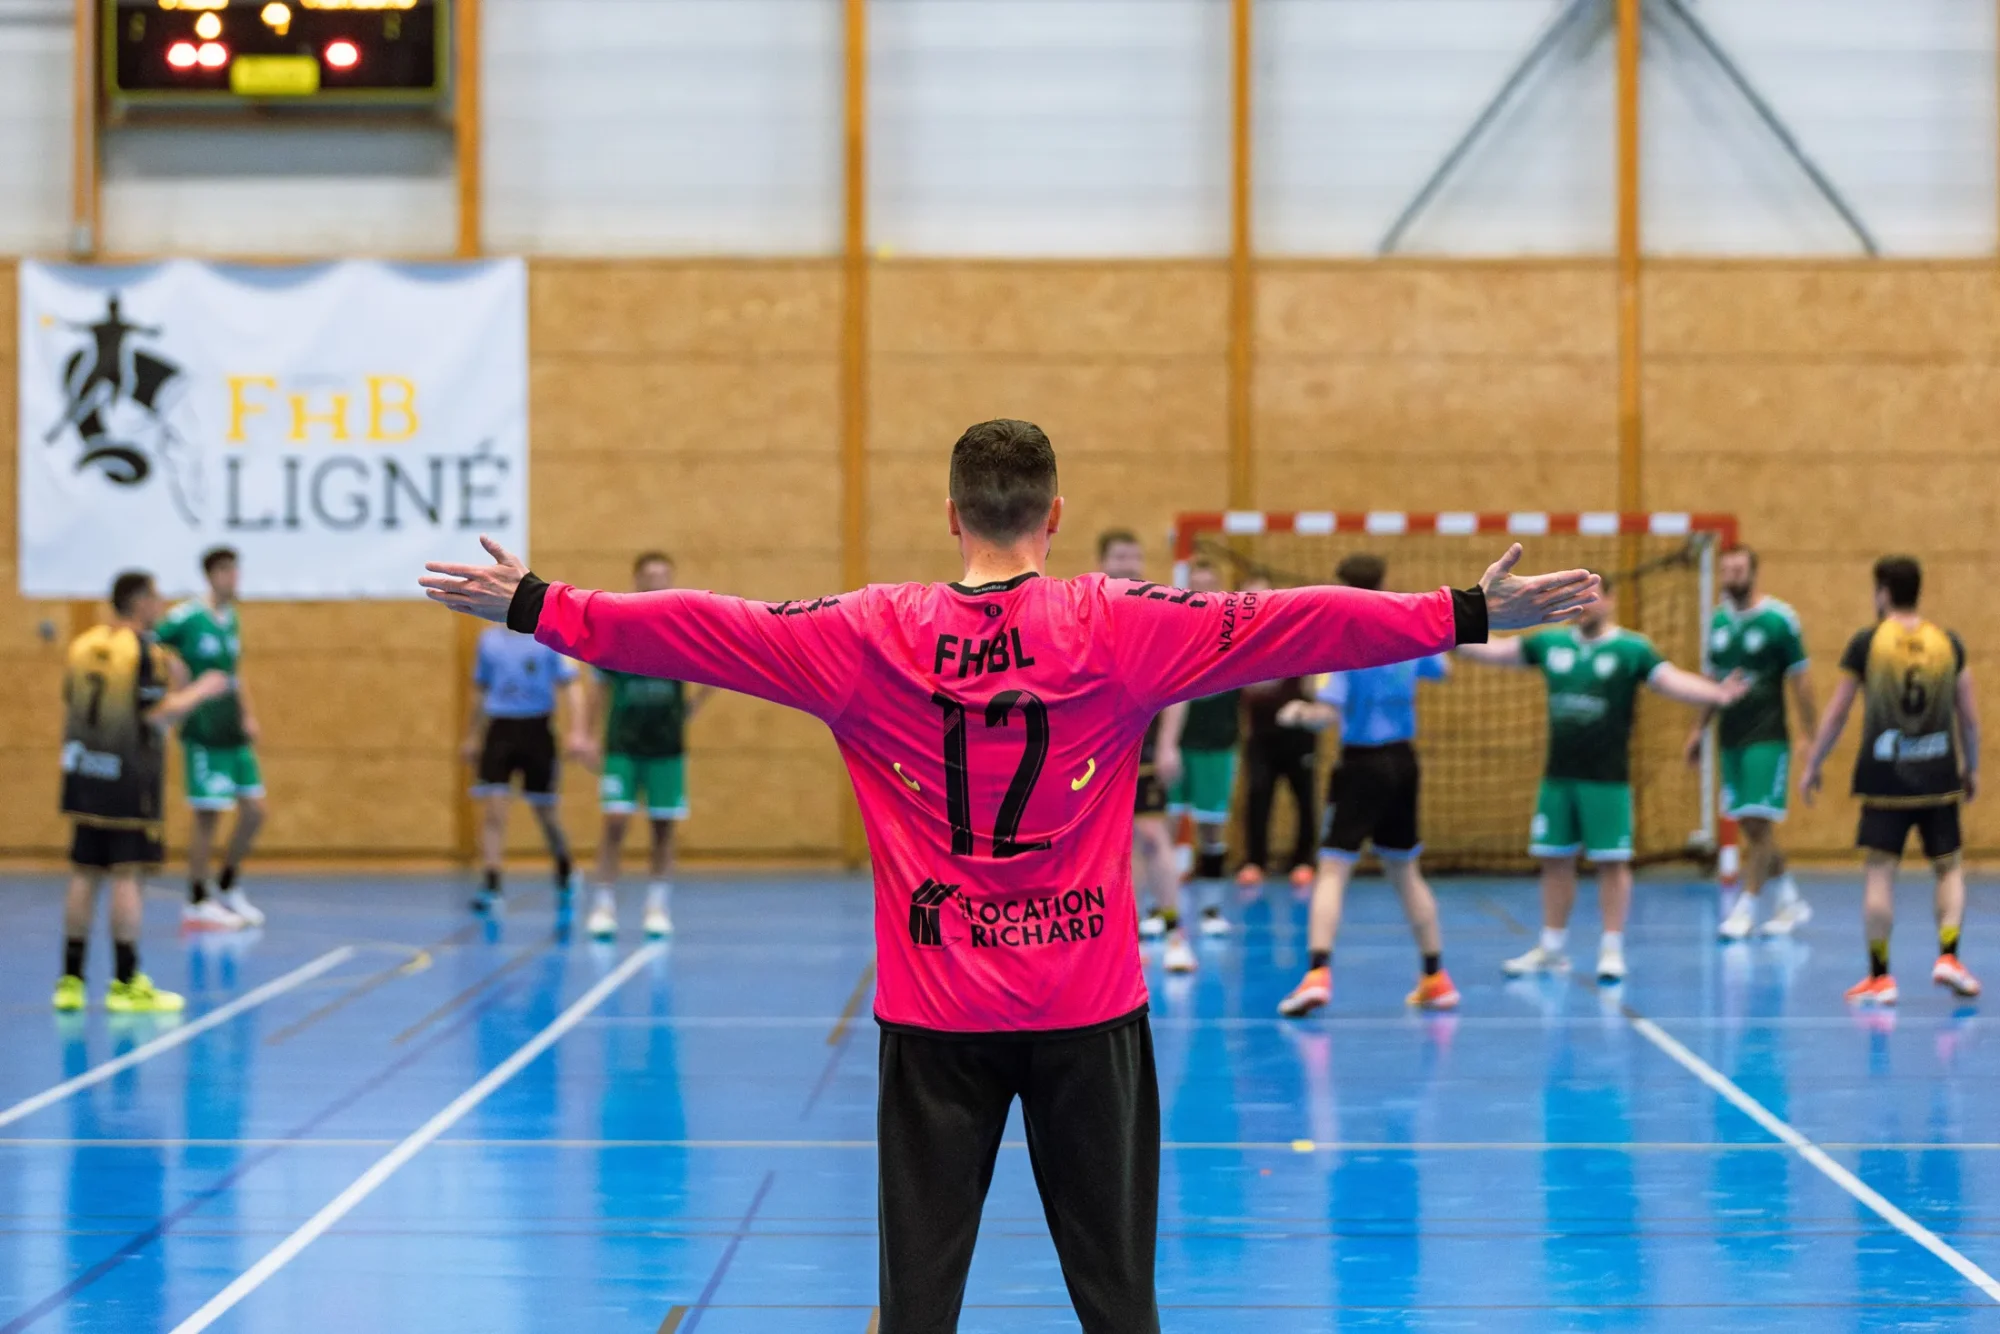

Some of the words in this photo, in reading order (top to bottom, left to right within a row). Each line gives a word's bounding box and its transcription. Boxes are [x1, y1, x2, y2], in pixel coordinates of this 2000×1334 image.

[225, 374, 422, 443] FHB
[225, 439, 511, 531] LIGNÉ
[1218, 592, 1238, 652] NAZAR
[934, 627, 1035, 678] FHBL
[931, 688, 1052, 859] 12
[965, 885, 1106, 924] LOCATION
[971, 914, 1105, 948] RICHARD
